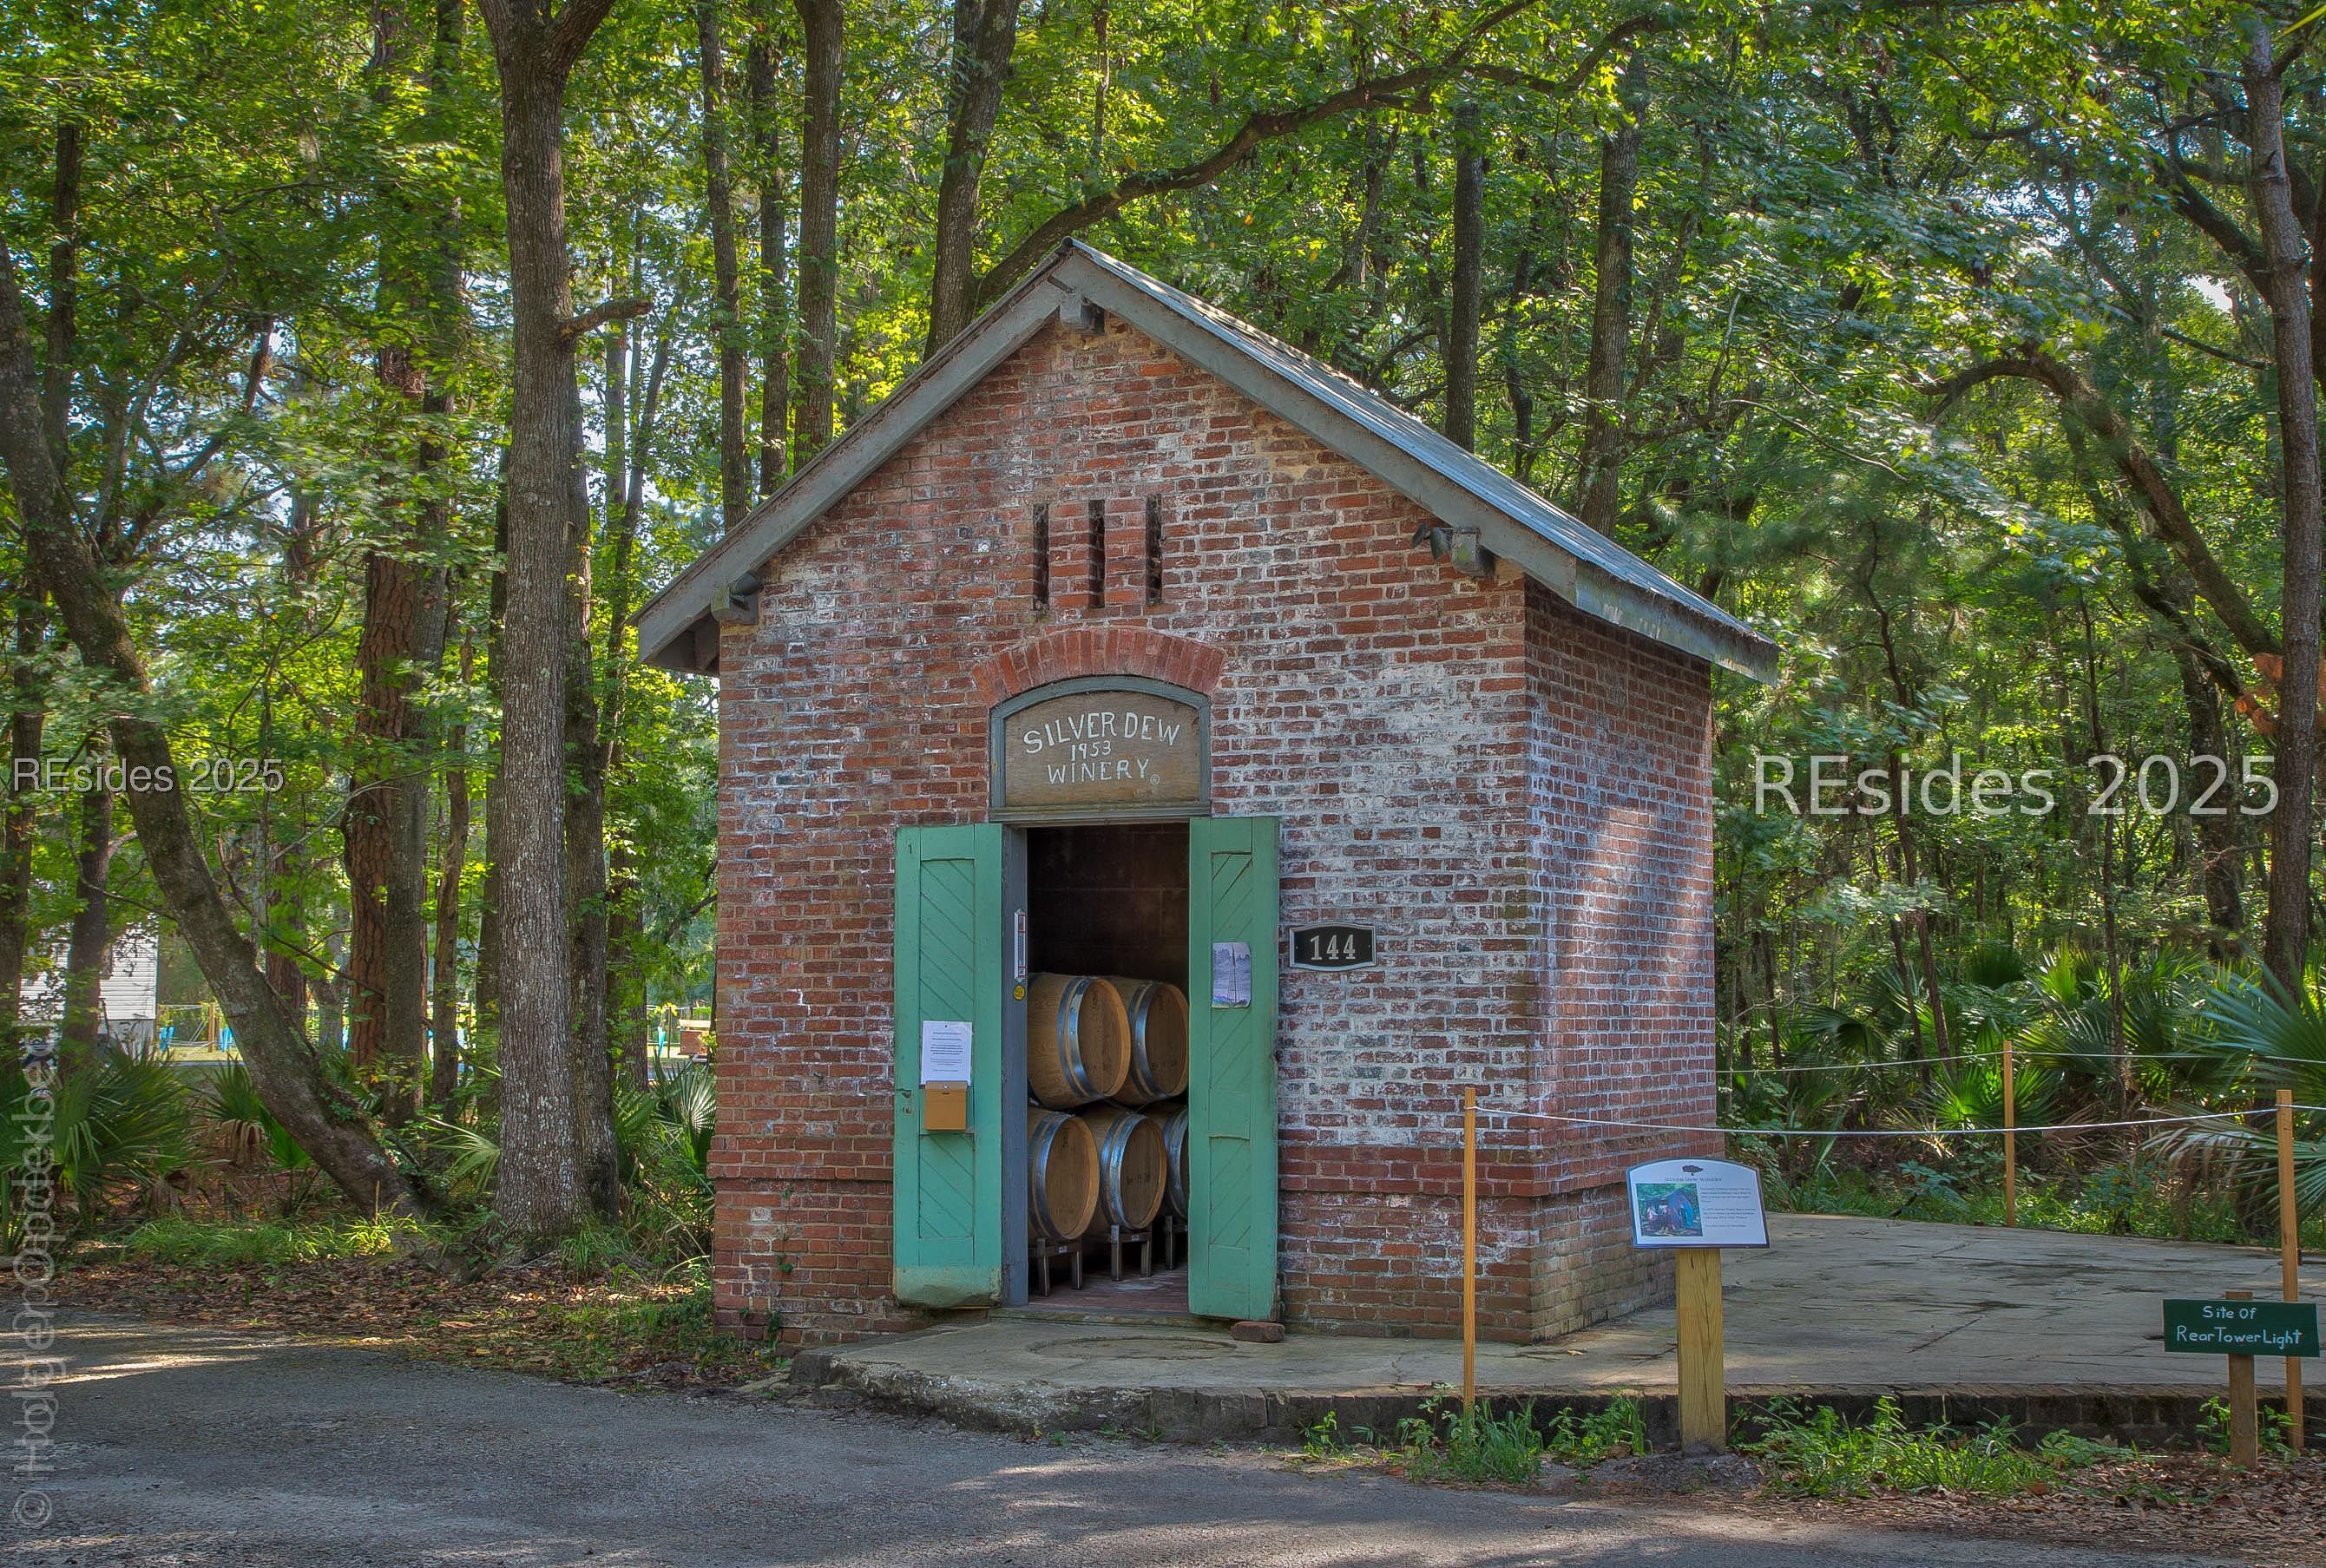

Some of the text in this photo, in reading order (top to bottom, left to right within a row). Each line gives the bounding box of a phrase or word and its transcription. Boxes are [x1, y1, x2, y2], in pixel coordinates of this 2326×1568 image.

[1023, 712, 1180, 753] SILVER DEW
[1071, 740, 1112, 762] 1953
[1047, 758, 1149, 784] WINERY
[1310, 934, 1357, 961] 144
[2202, 1305, 2257, 1320] Site Of
